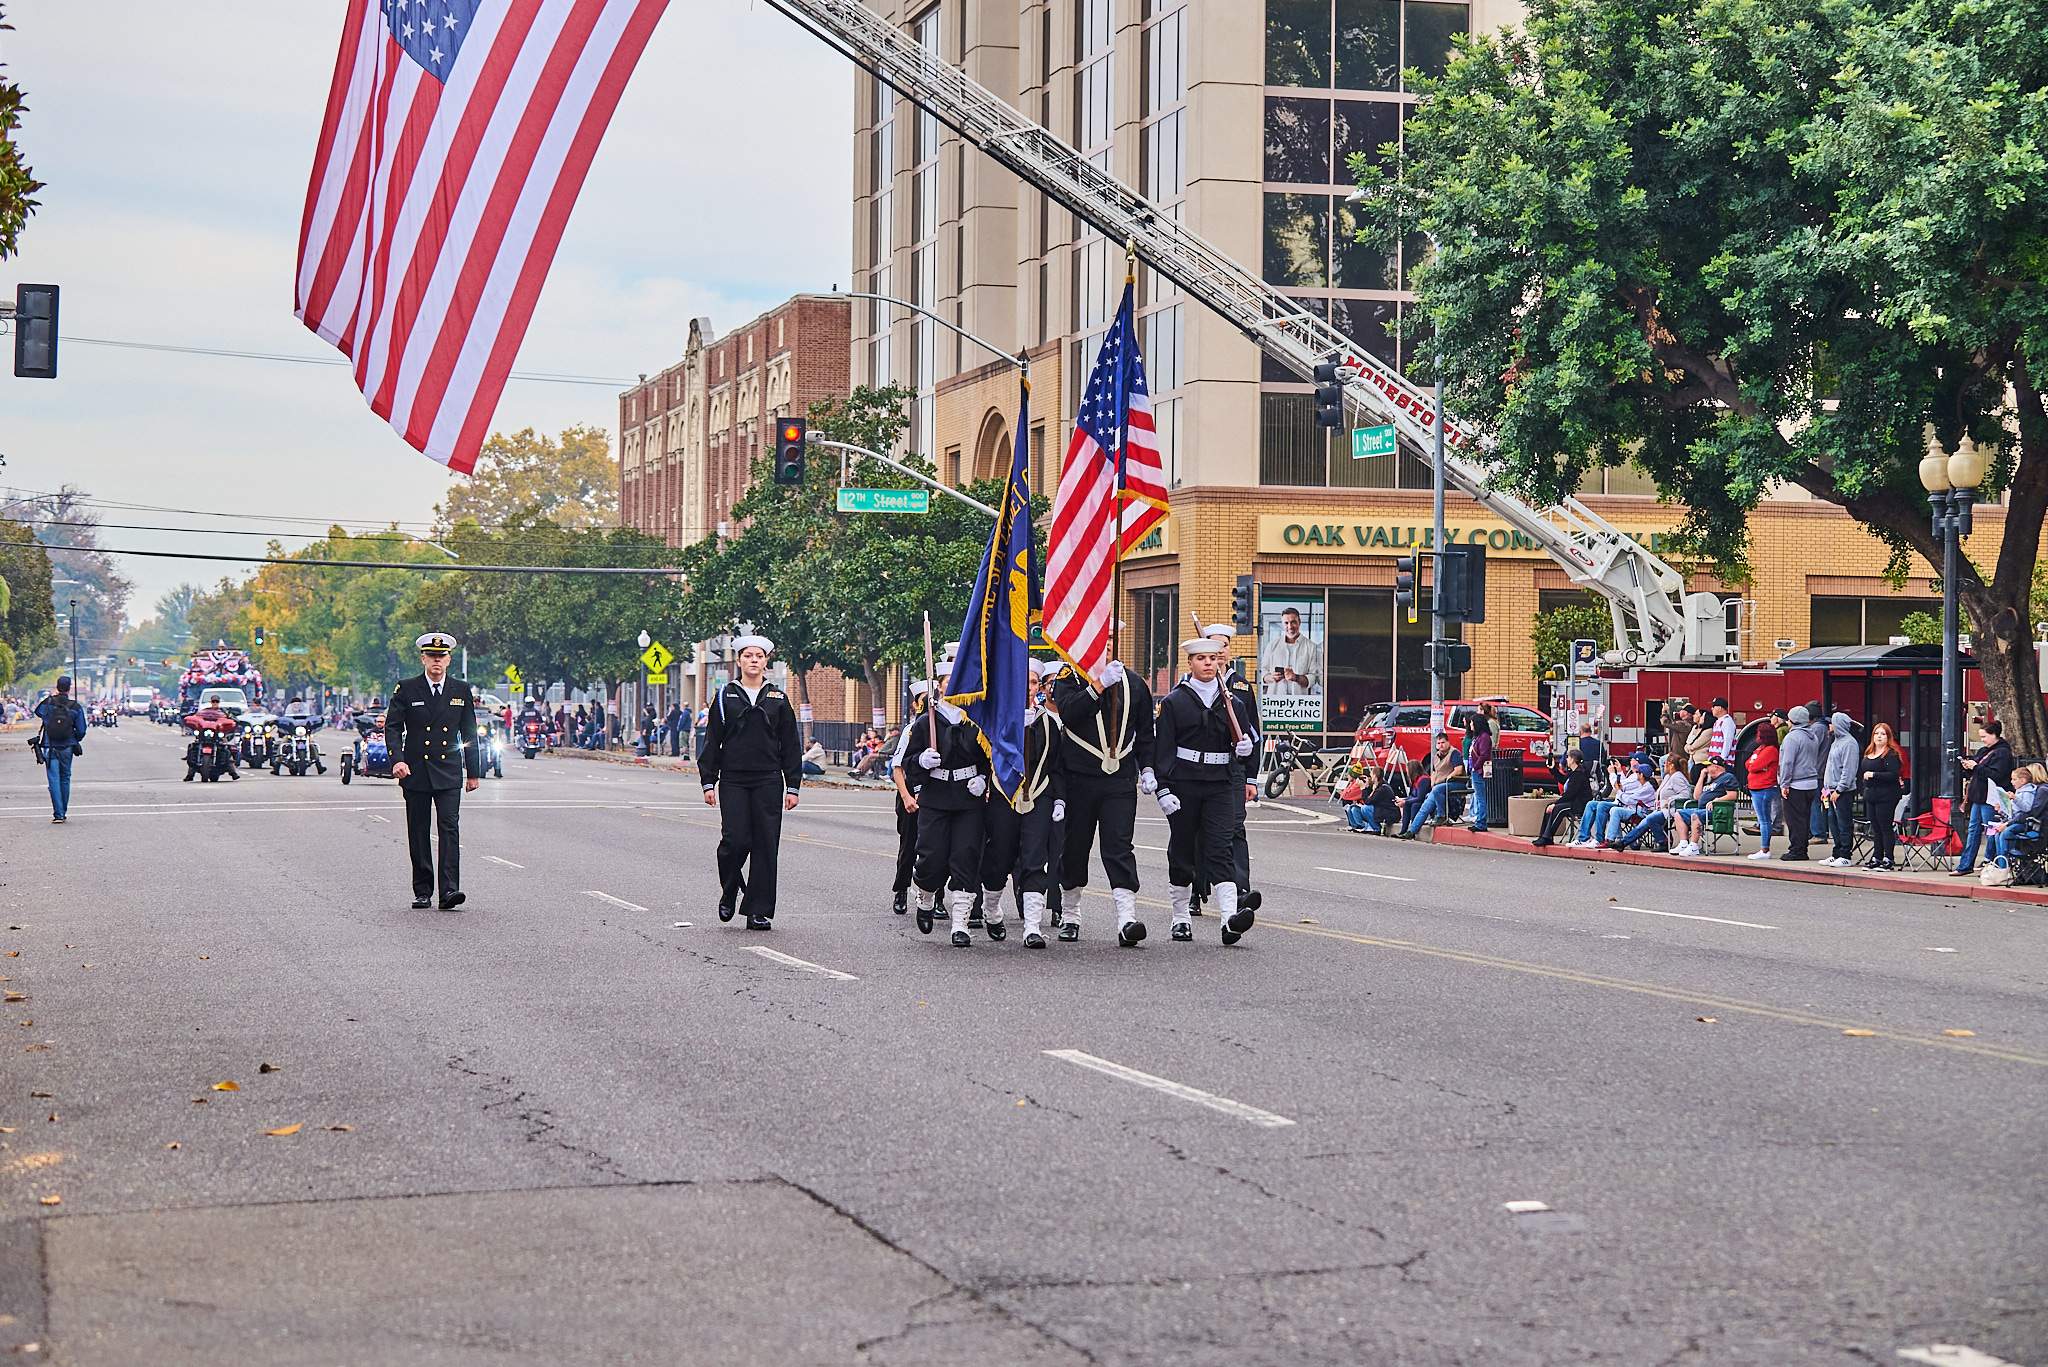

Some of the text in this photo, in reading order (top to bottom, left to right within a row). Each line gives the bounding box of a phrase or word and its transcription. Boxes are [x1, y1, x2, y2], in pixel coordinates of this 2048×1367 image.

[1344, 356, 1436, 426] MODESTO
[1355, 431, 1383, 452] I Street
[844, 493, 908, 509] 12TH Street
[1283, 524, 1346, 547] OAK
[1354, 526, 1460, 548] VALLEY
[1262, 698, 1321, 708] Simply Free
[1262, 709, 1321, 718] CHECKING
